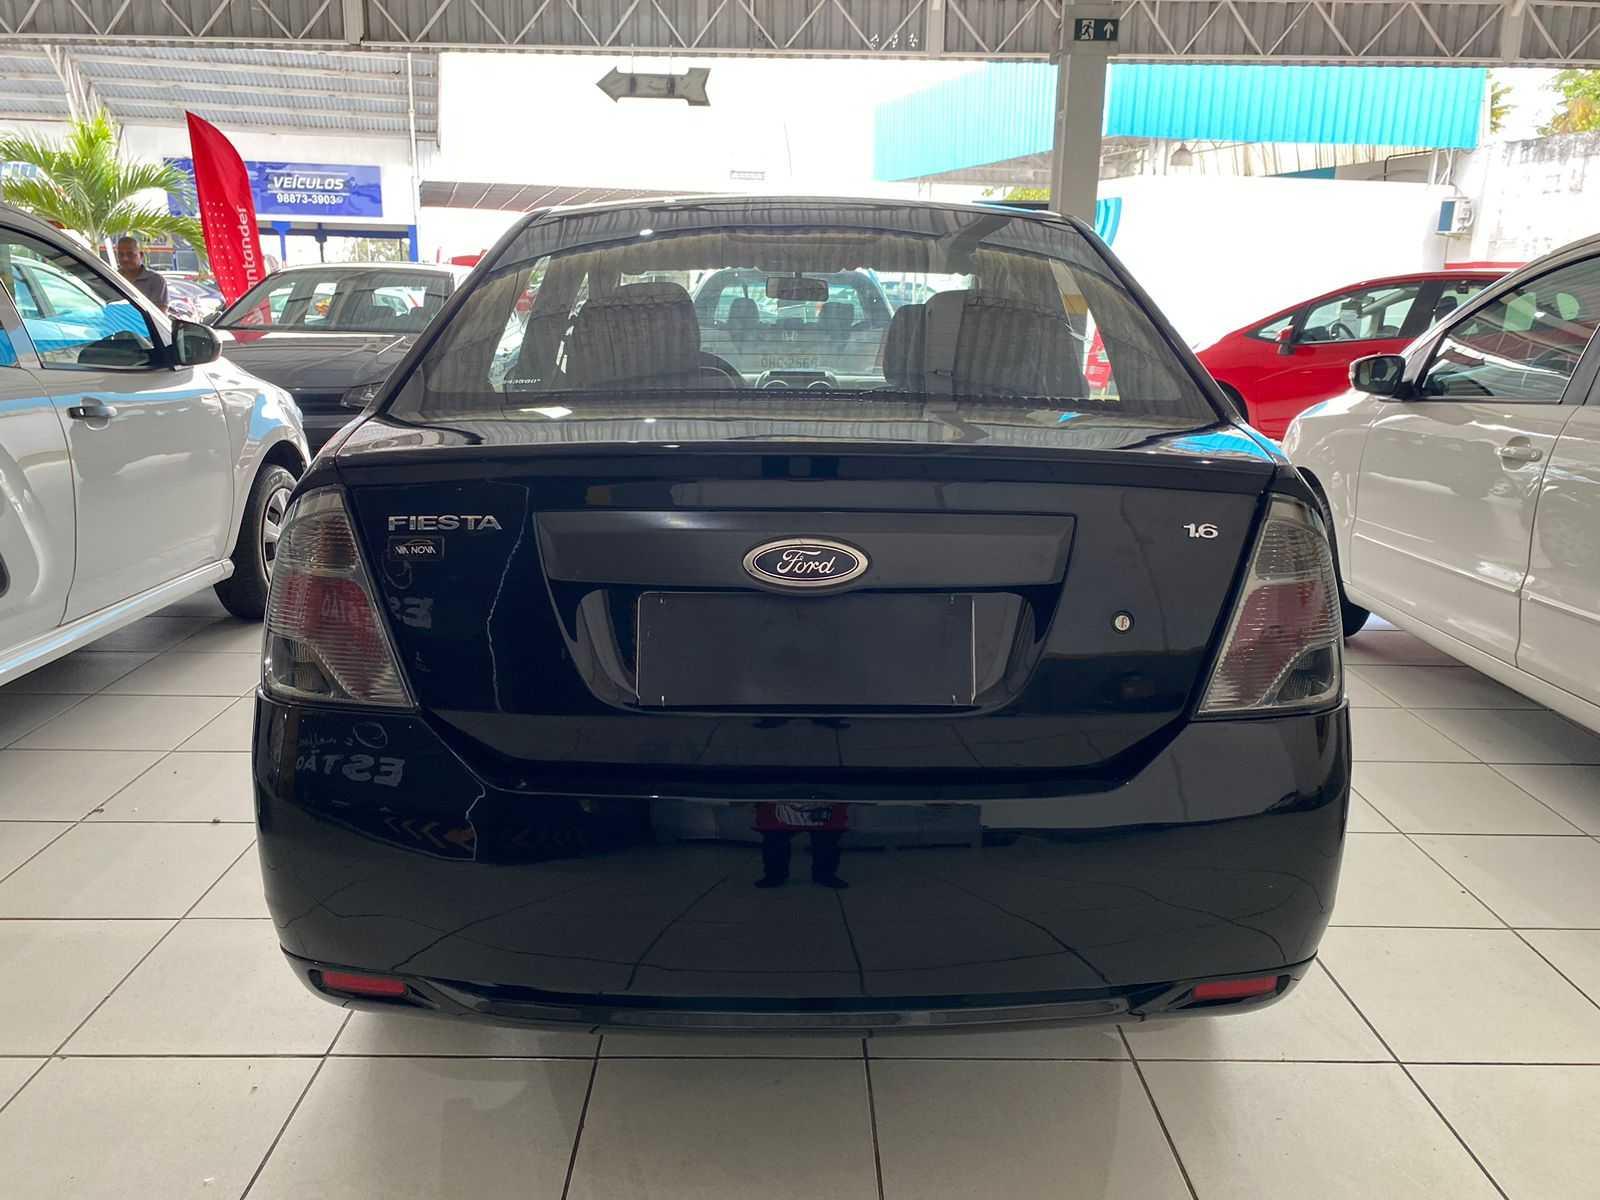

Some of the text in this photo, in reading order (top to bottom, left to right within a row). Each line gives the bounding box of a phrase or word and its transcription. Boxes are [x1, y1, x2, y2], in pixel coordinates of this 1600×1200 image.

[273, 174, 345, 190] VEÍCULOS
[276, 193, 336, 205] 98873-3903
[236, 204, 258, 290] antander
[387, 514, 503, 531] FIESTA
[1183, 522, 1219, 539] 1.6
[411, 545, 437, 555] NOVA
[776, 548, 836, 574] Ford
